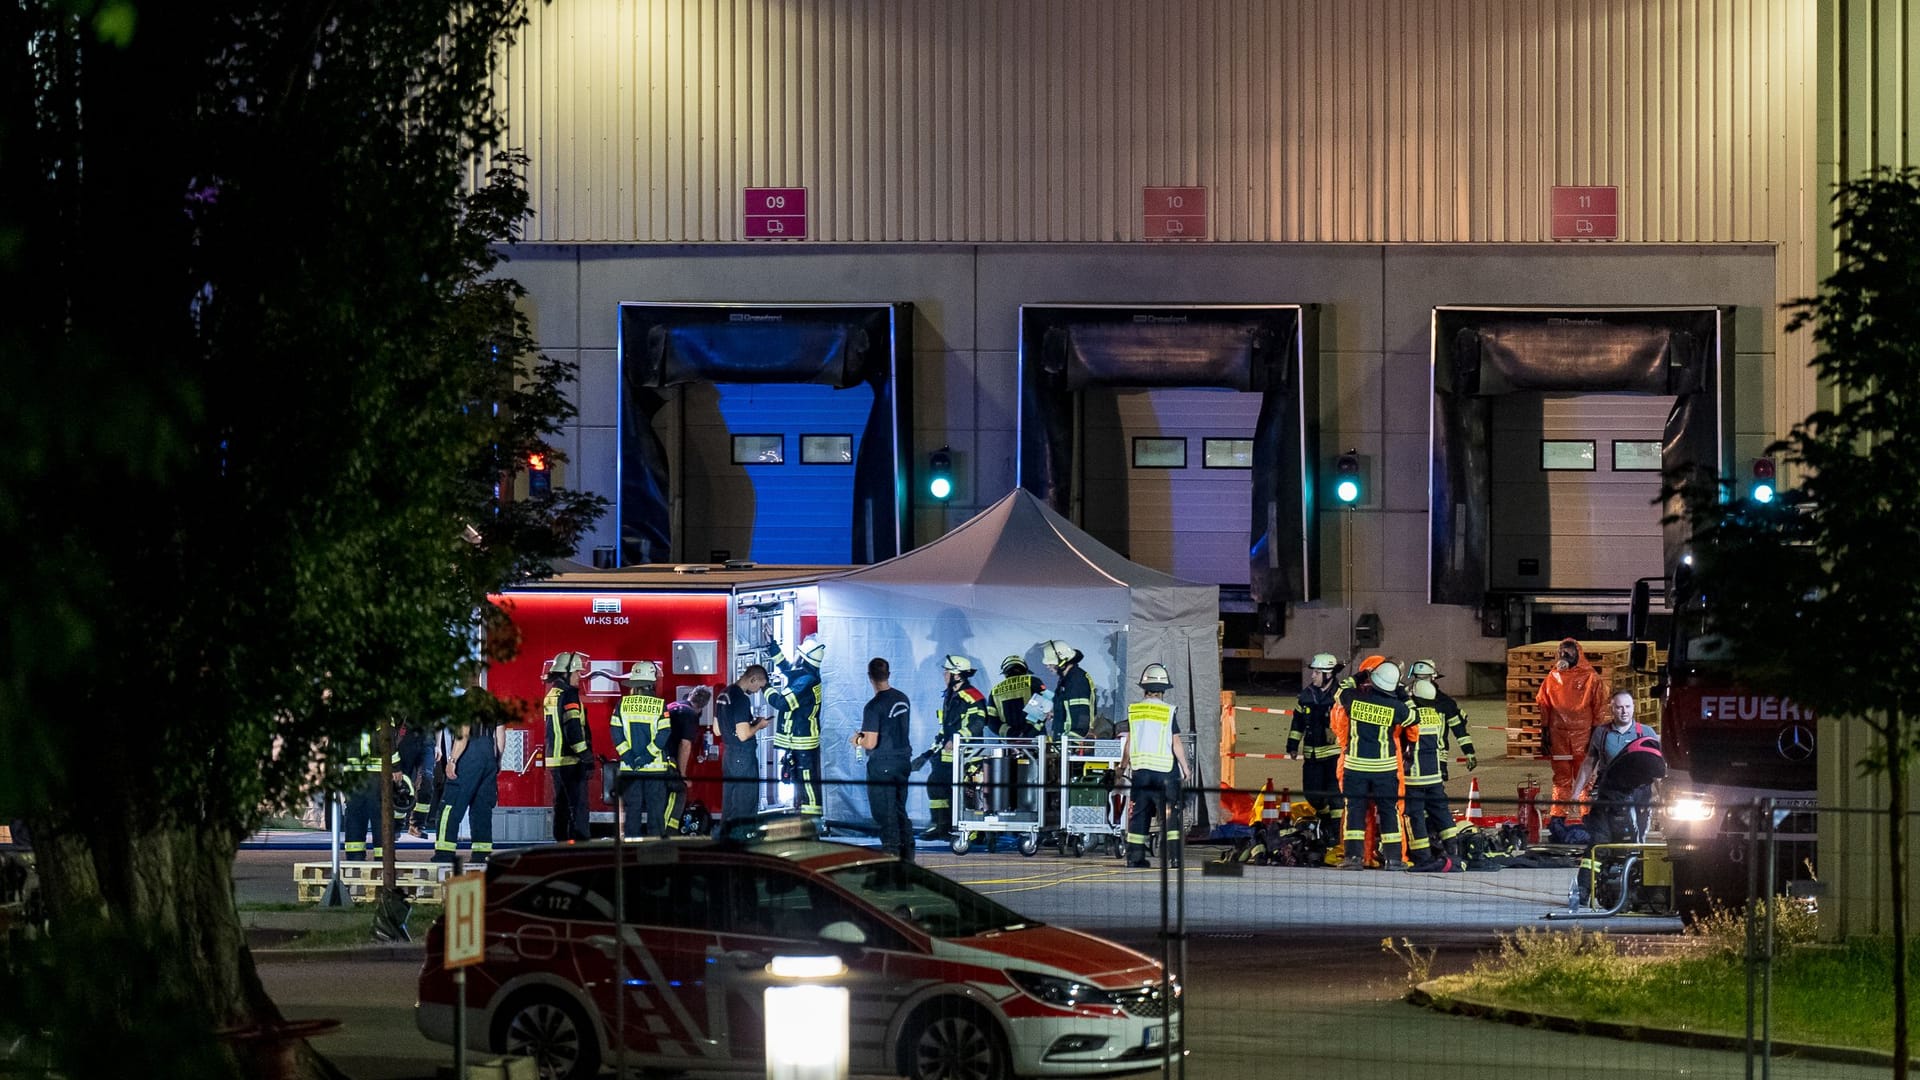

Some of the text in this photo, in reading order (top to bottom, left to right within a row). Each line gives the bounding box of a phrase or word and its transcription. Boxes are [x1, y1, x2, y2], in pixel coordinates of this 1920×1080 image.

[766, 196, 785, 208] 09
[1167, 196, 1183, 208] 10
[1579, 196, 1591, 208] 11
[583, 616, 630, 625] WI-KS 504
[623, 696, 663, 706] FEUERWEHR
[622, 704, 662, 714] WIESBADEN
[1353, 702, 1391, 716] FEUERWEHR
[1352, 709, 1391, 726] WIESBADEN
[549, 896, 571, 910] 112
[456, 891, 475, 949] H
